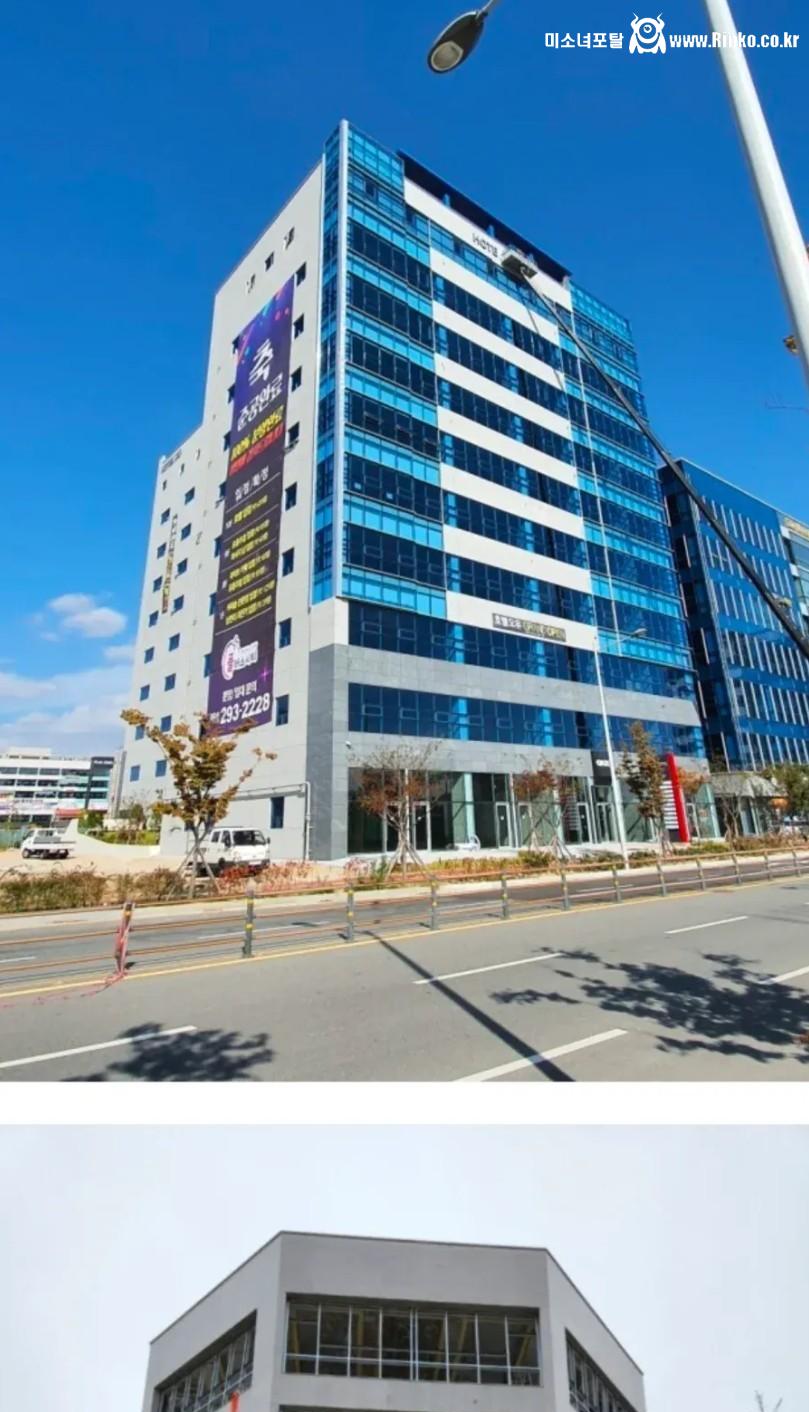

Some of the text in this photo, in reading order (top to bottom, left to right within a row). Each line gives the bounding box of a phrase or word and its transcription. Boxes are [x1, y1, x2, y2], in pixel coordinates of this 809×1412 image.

[248, 338, 274, 386] 축
[237, 372, 284, 432] 준공완료
[220, 692, 271, 725] 293-2228
